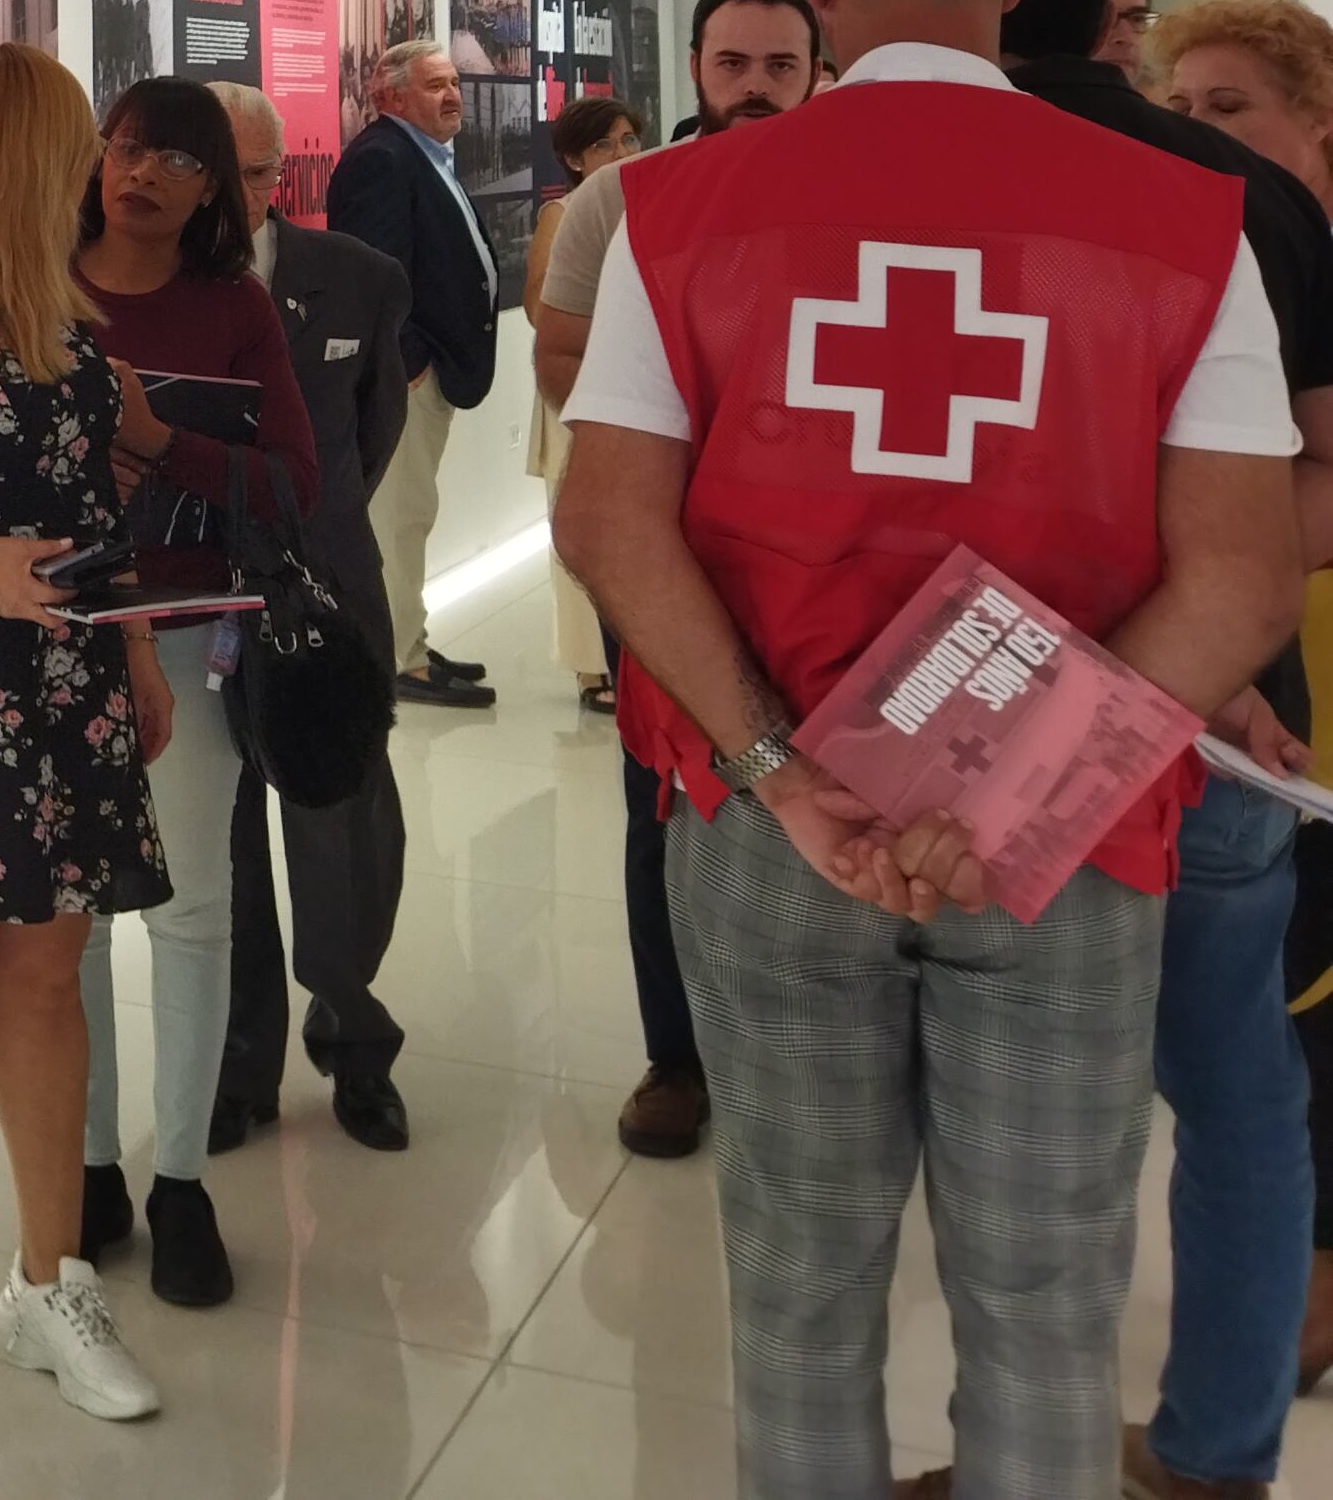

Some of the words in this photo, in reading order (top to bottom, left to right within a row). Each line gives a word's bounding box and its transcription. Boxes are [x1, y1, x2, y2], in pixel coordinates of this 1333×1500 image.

[972, 586, 1023, 629] DE
[1005, 616, 1061, 667] 150
[879, 609, 1001, 735] SOLIDARIDAD
[964, 646, 1033, 711] AÑOS
